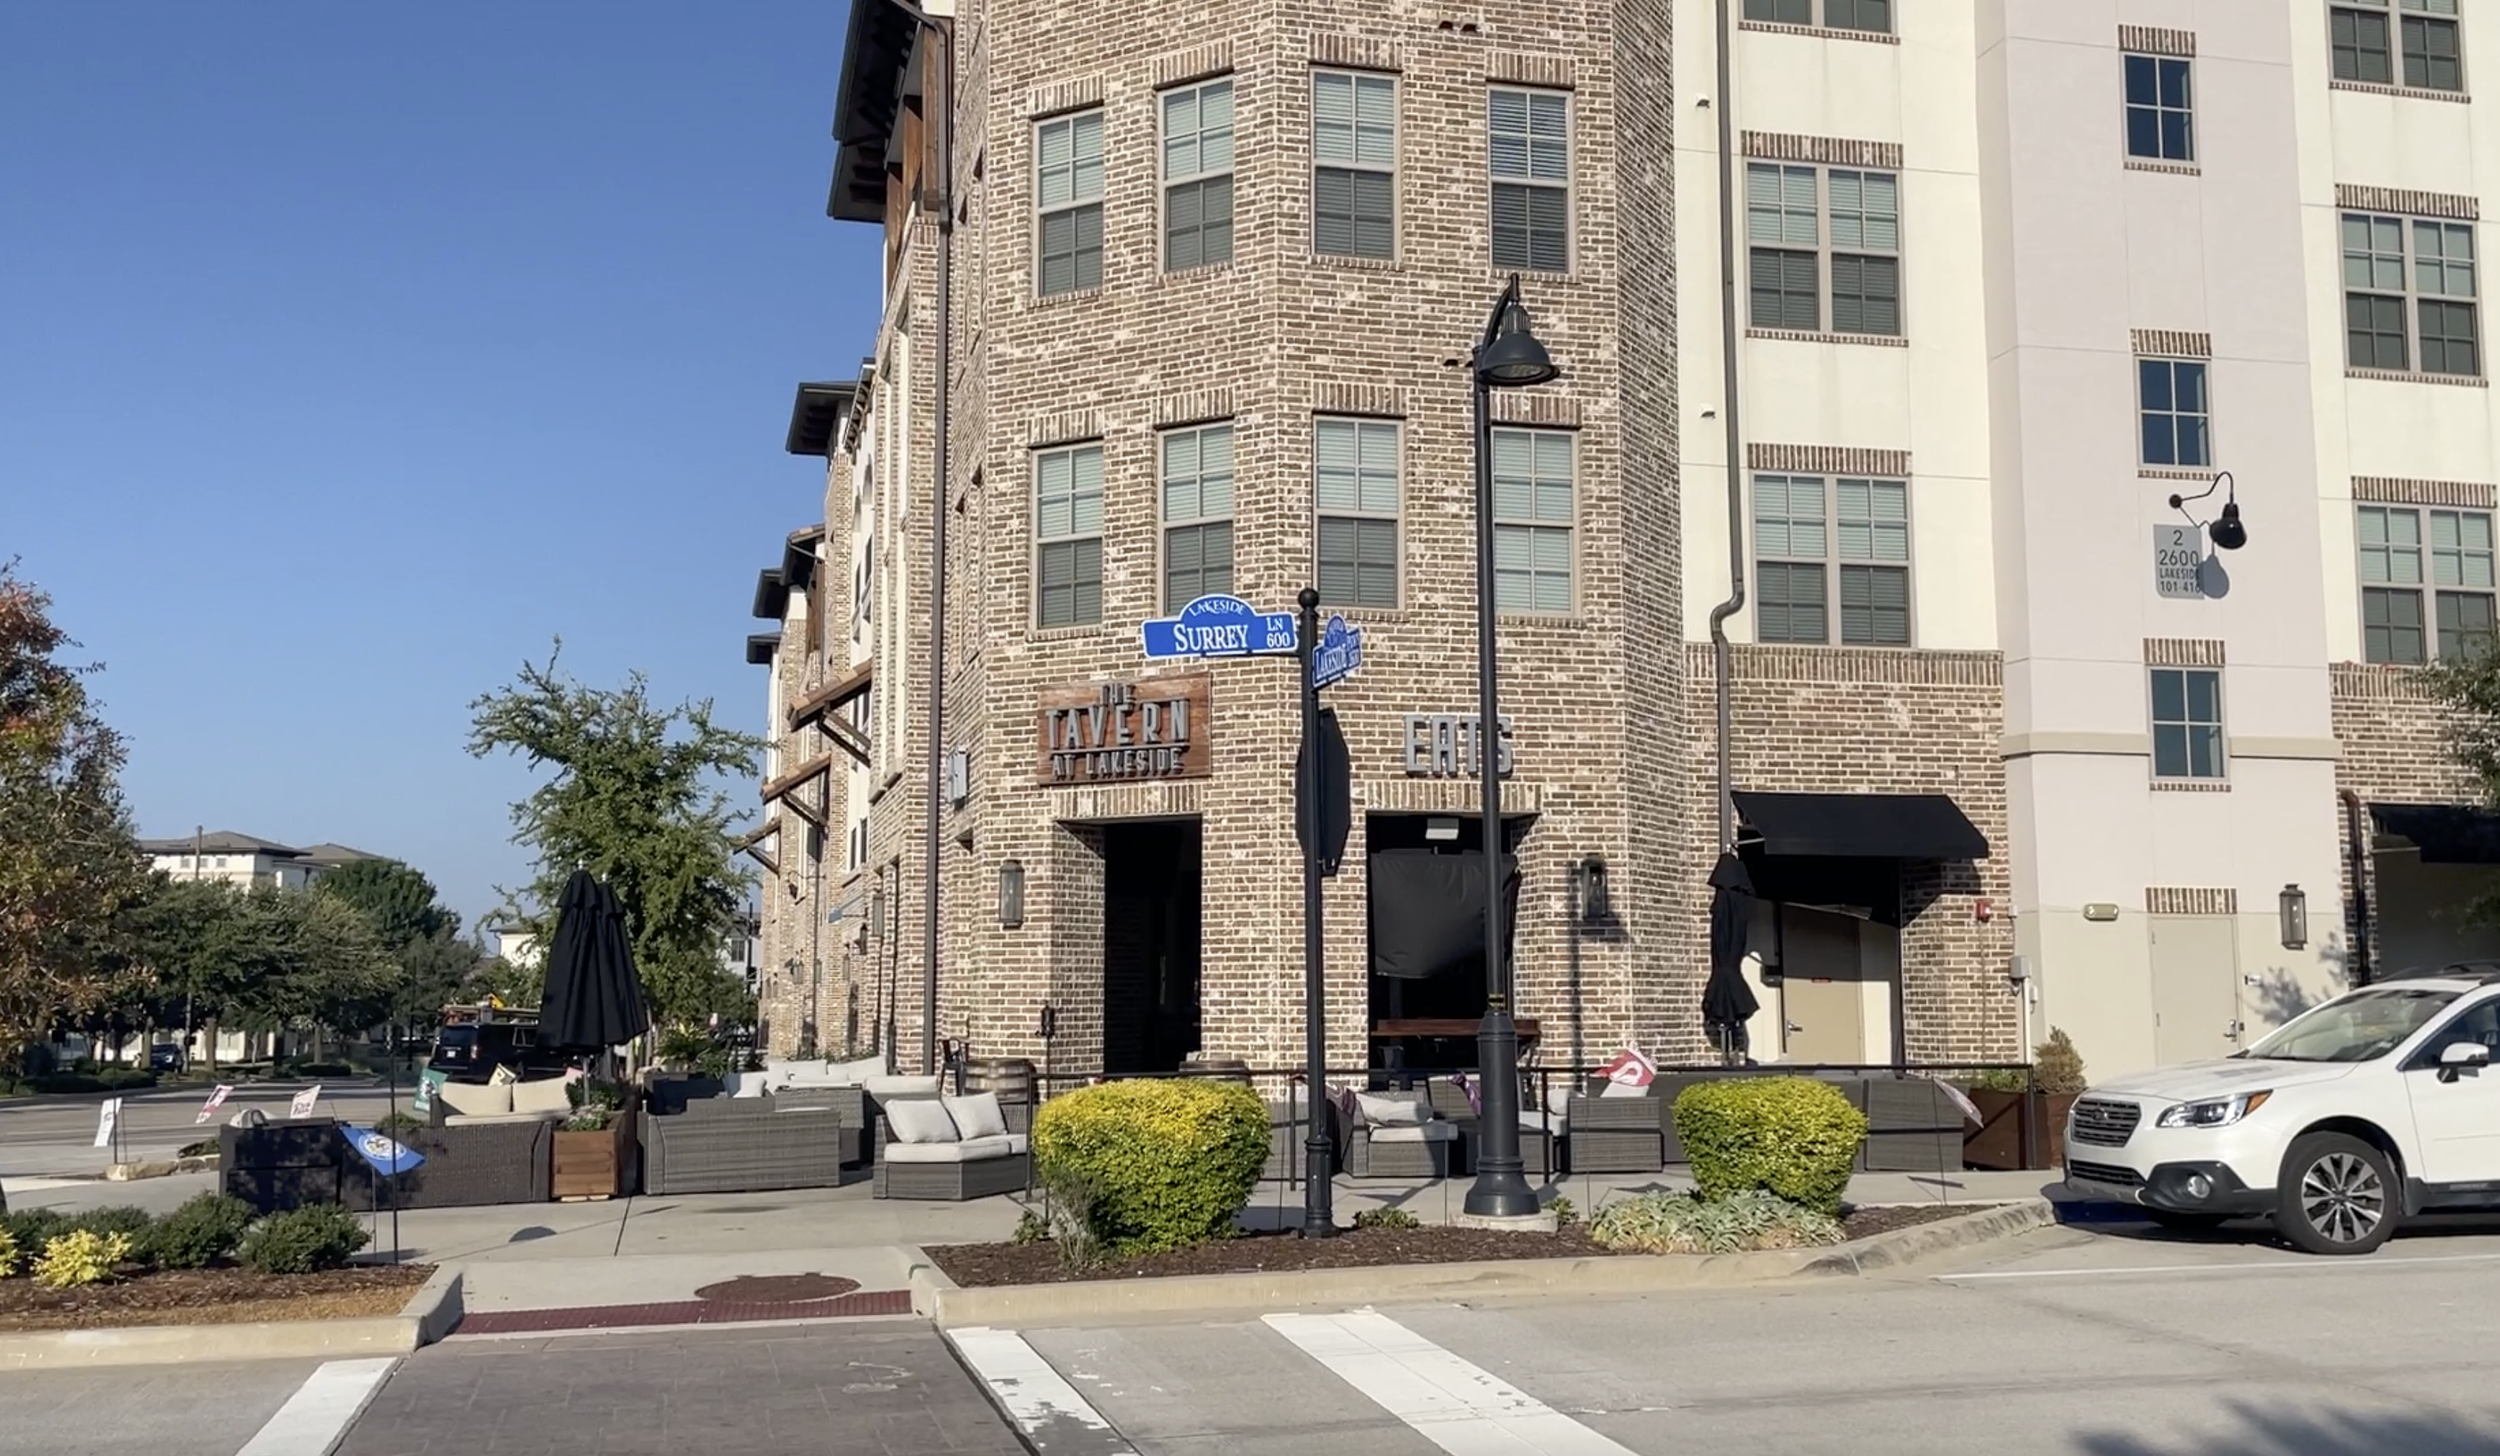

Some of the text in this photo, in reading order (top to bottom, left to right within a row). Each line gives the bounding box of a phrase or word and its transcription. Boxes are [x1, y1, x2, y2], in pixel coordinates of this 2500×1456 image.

[2173, 529, 2184, 546] 2
[2159, 549, 2199, 567] 2600
[1188, 600, 1245, 617] LAKESIDE
[1266, 616, 1283, 632] LN
[1173, 623, 1249, 652] SURREY
[1266, 631, 1291, 648] 600
[1099, 682, 1136, 704] THE
[1045, 699, 1189, 749] TAVERN
[1405, 713, 1513, 777] EATS
[1052, 747, 1185, 780] AT LAKESIDE
